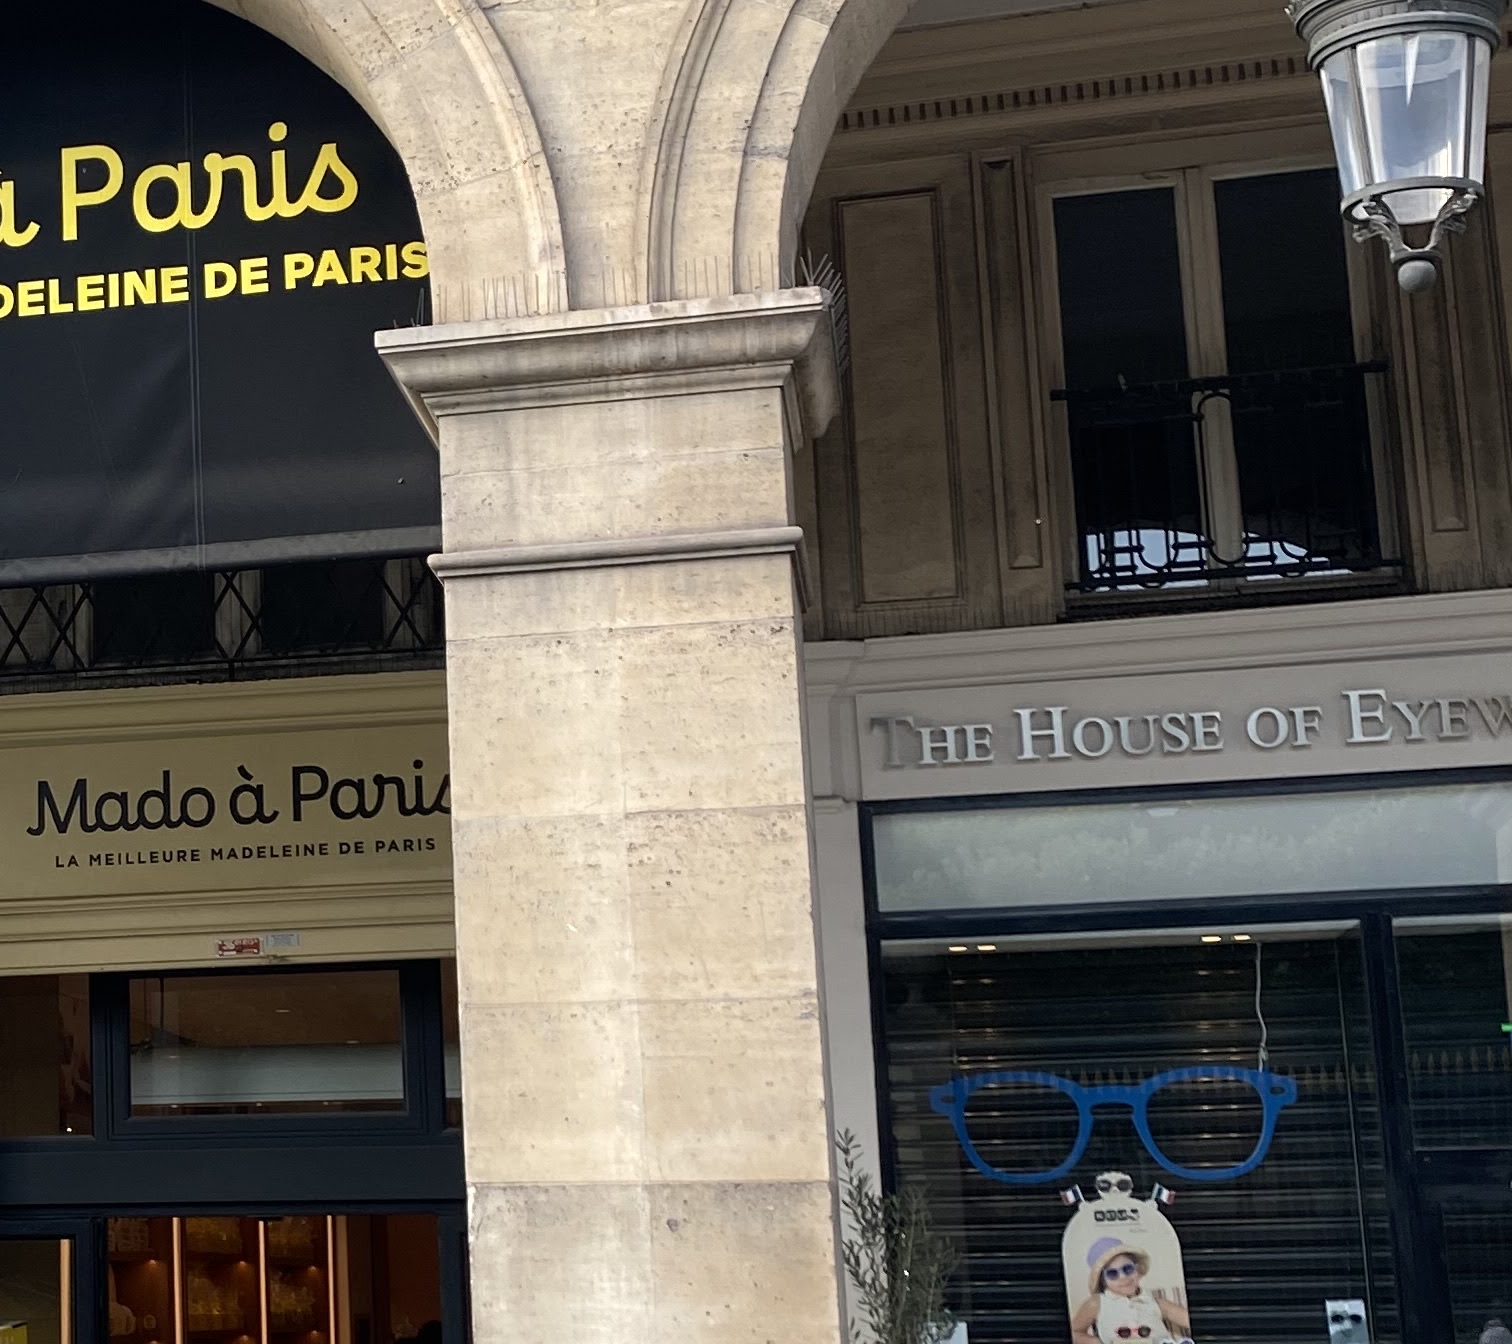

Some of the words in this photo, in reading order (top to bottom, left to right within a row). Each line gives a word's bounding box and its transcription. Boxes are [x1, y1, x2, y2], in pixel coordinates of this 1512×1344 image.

[61, 121, 358, 242] Paris
[204, 256, 269, 299] DE
[284, 241, 429, 290] PARIS
[1013, 706, 1224, 761] HOUSE
[1246, 706, 1323, 749] OF
[26, 769, 216, 836] Mado
[229, 764, 280, 825] à
[55, 855, 79, 868] LA
[89, 849, 201, 867] MEILLEURE
[211, 843, 329, 861] MADELEINE
[339, 841, 365, 854] DE
[375, 837, 436, 853] PARIS
